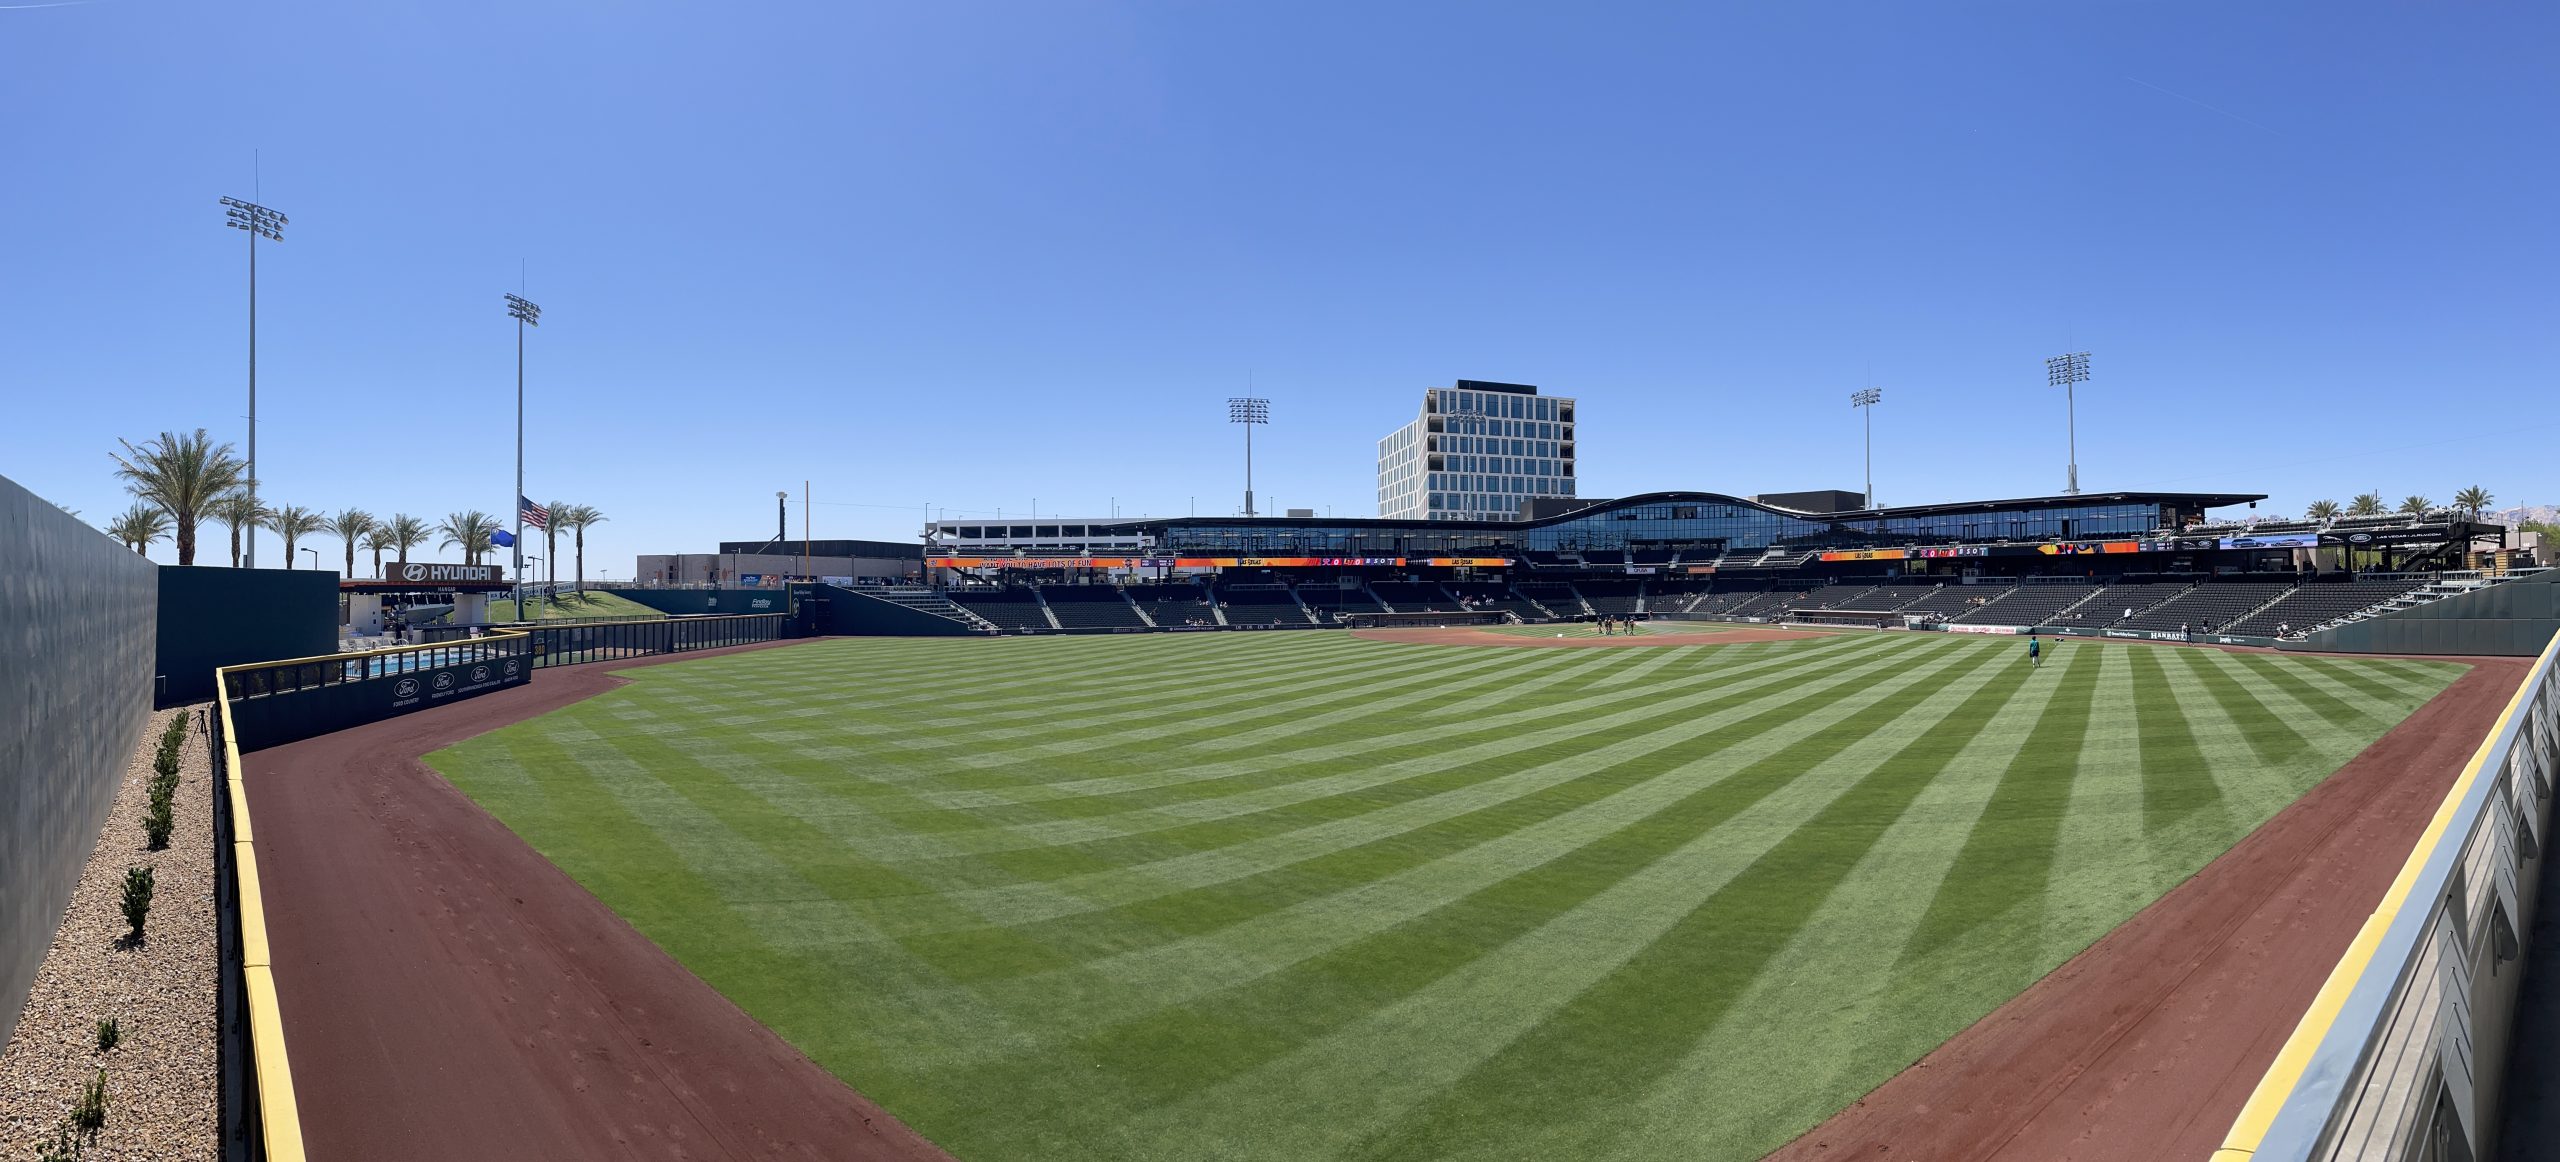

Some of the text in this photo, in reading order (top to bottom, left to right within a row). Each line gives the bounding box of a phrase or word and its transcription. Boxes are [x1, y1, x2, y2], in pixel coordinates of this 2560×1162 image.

[431, 566, 491, 580] HYUNDAI
[506, 663, 518, 672] Ford
[475, 668, 487, 680] Ford
[436, 674, 451, 687] Ford
[399, 682, 415, 694] Ford
